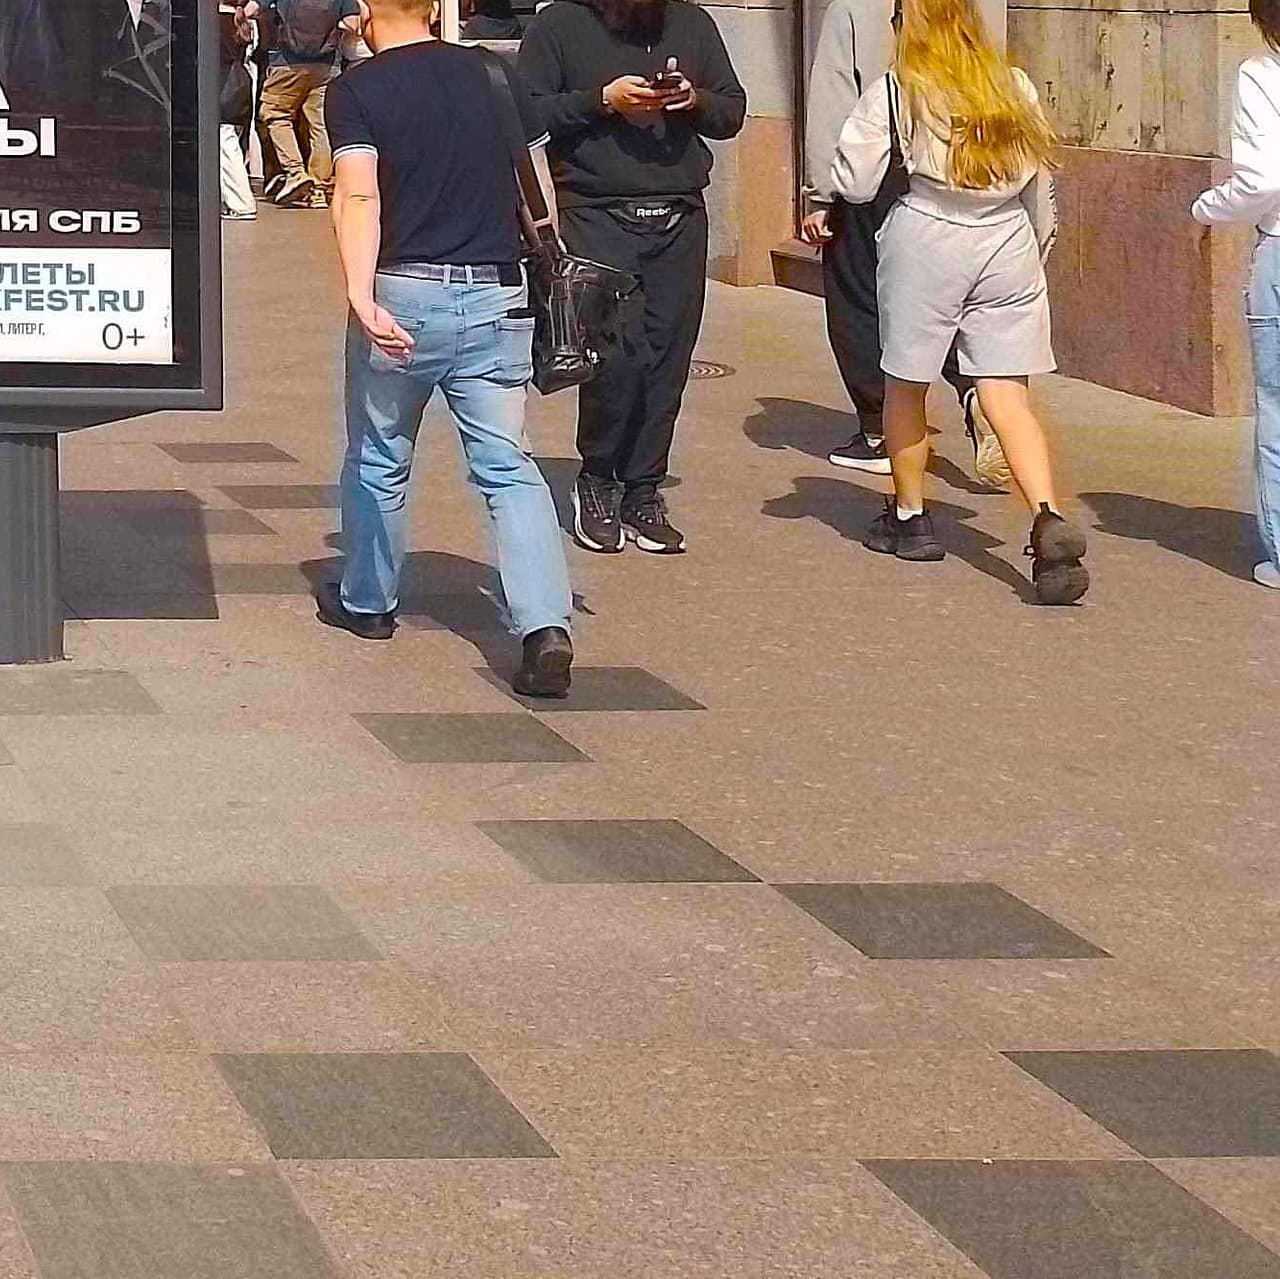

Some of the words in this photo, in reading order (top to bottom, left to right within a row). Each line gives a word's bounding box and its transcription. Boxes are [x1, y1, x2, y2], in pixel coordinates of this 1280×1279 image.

[48, 209, 142, 234] СПБ
[6, 323, 38, 336] ЛИТЕР
[101, 322, 146, 351] 0+
